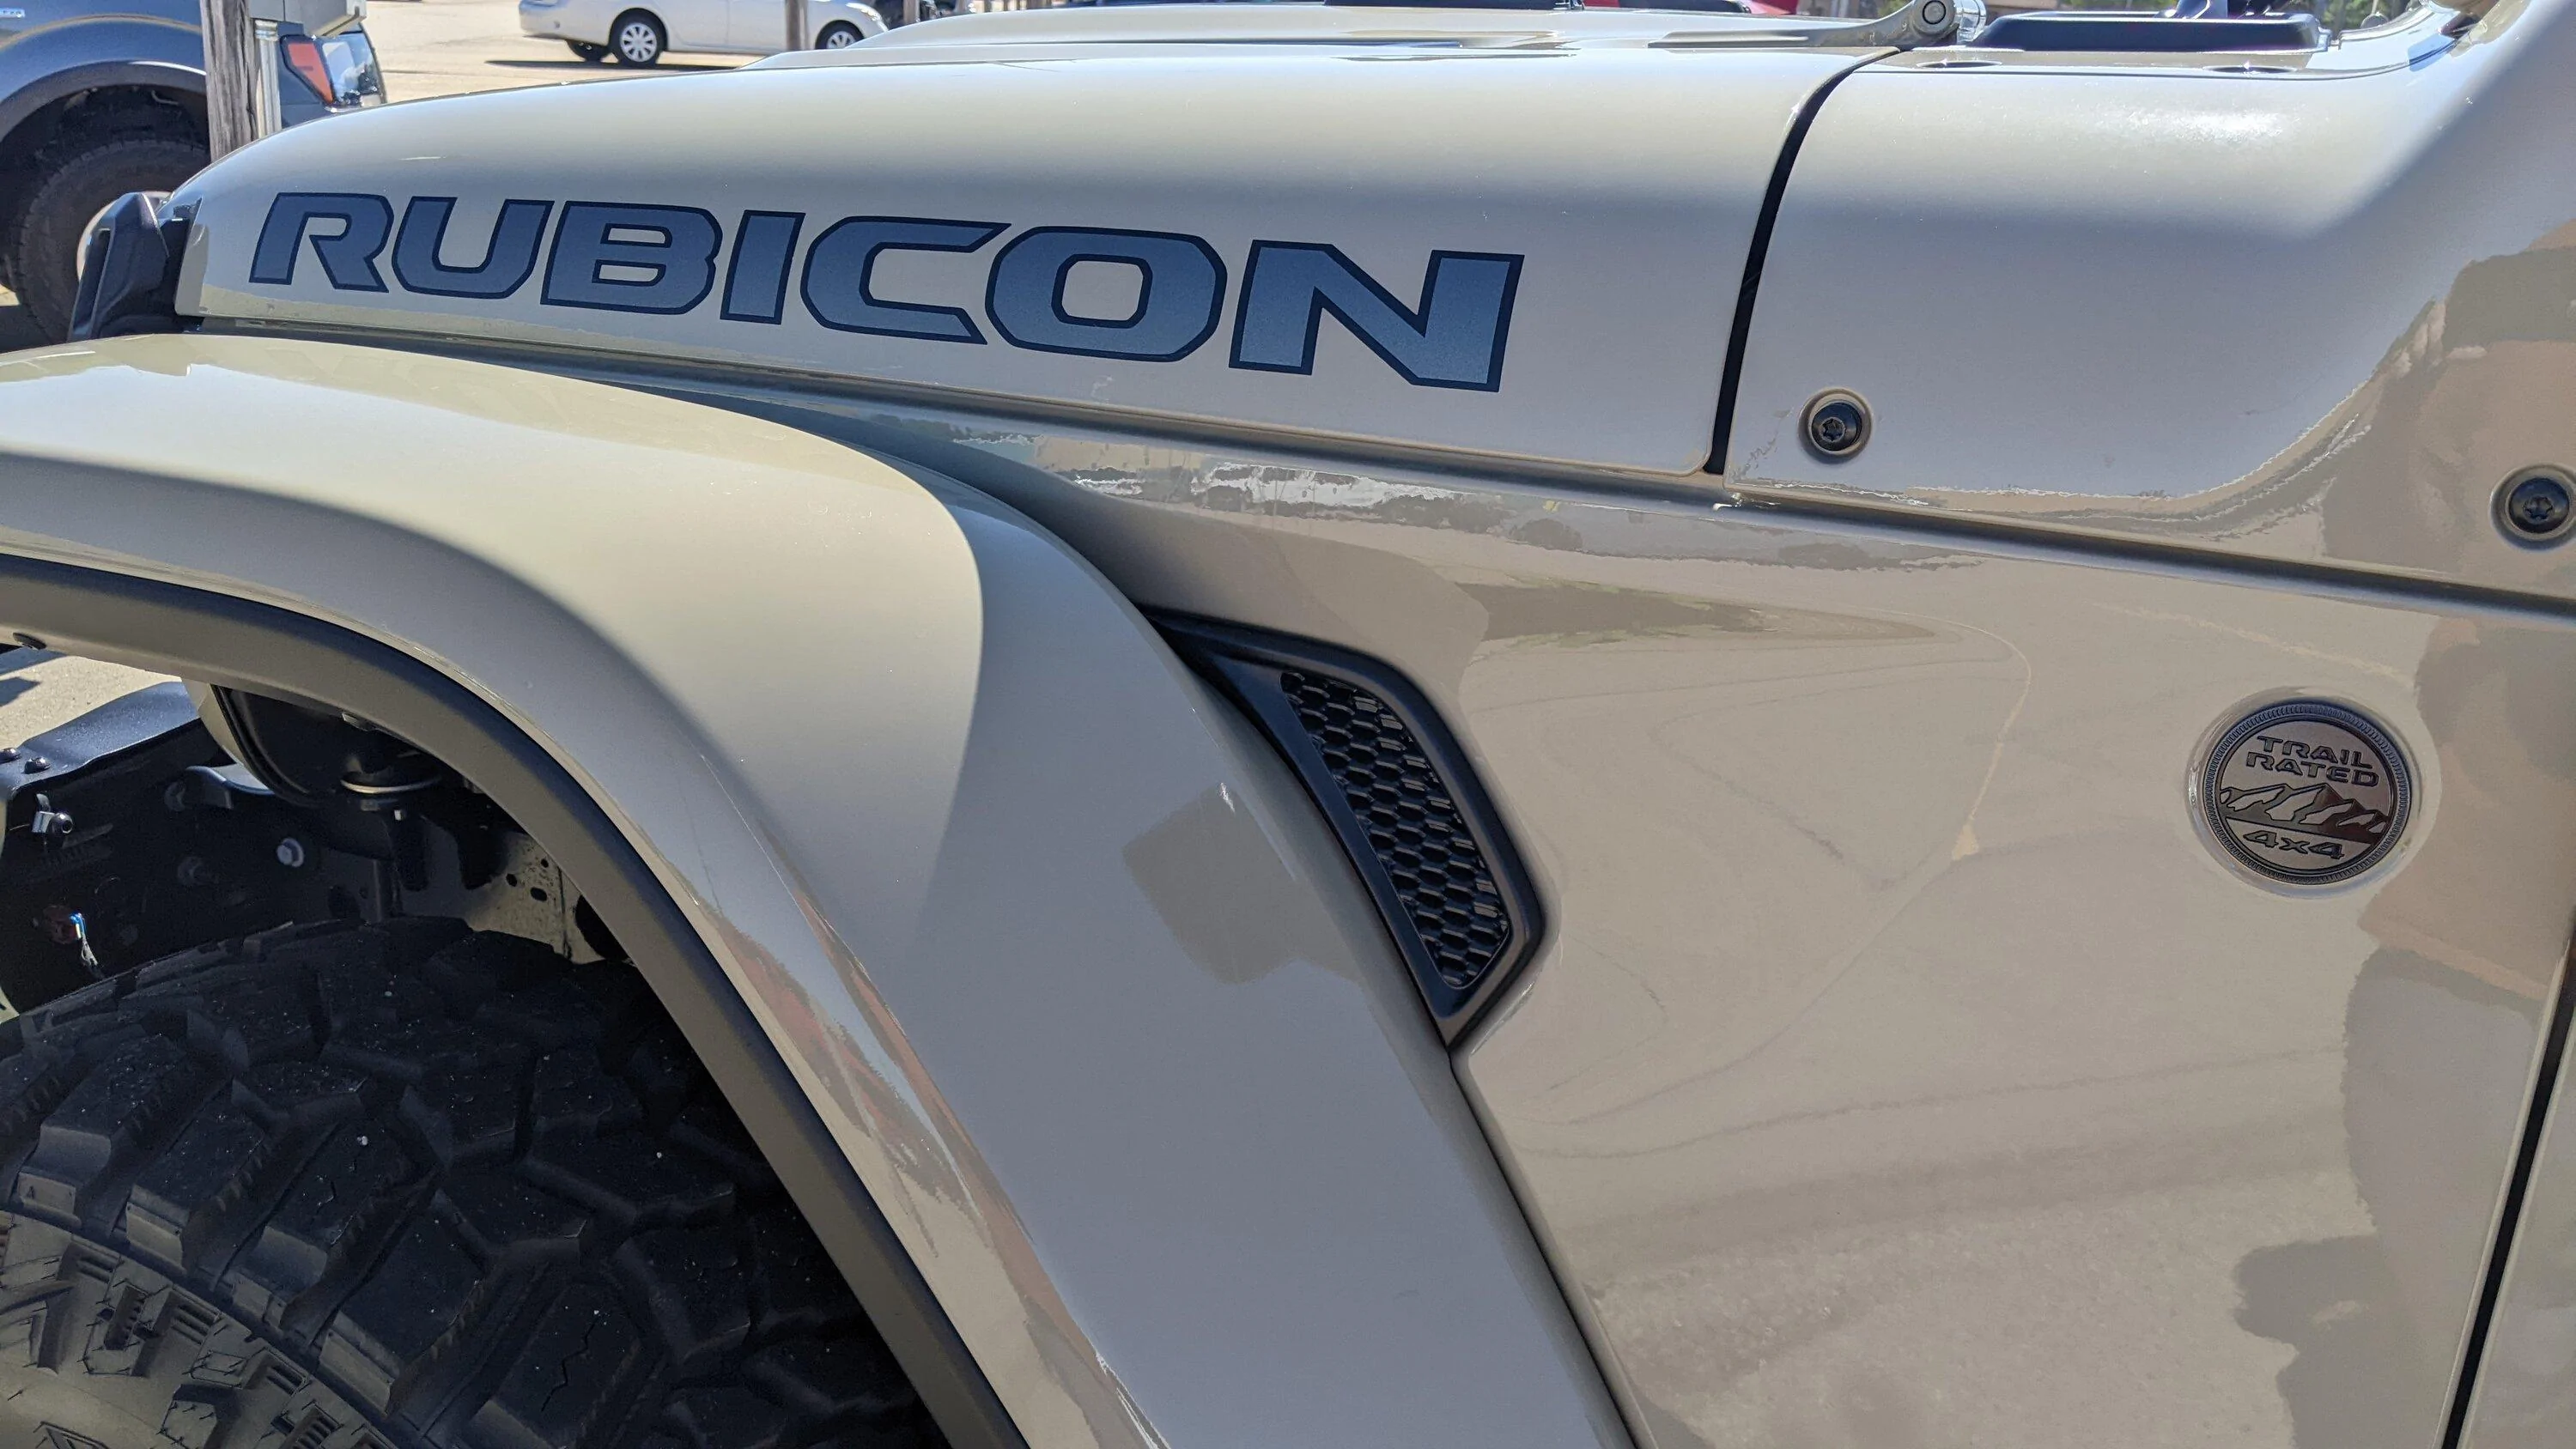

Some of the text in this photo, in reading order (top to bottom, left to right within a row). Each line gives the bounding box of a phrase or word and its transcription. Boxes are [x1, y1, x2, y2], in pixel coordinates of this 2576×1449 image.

[249, 191, 1524, 393] RUBICON
[2245, 750, 2380, 787] RATED
[2257, 735, 2374, 769] TRAIL
